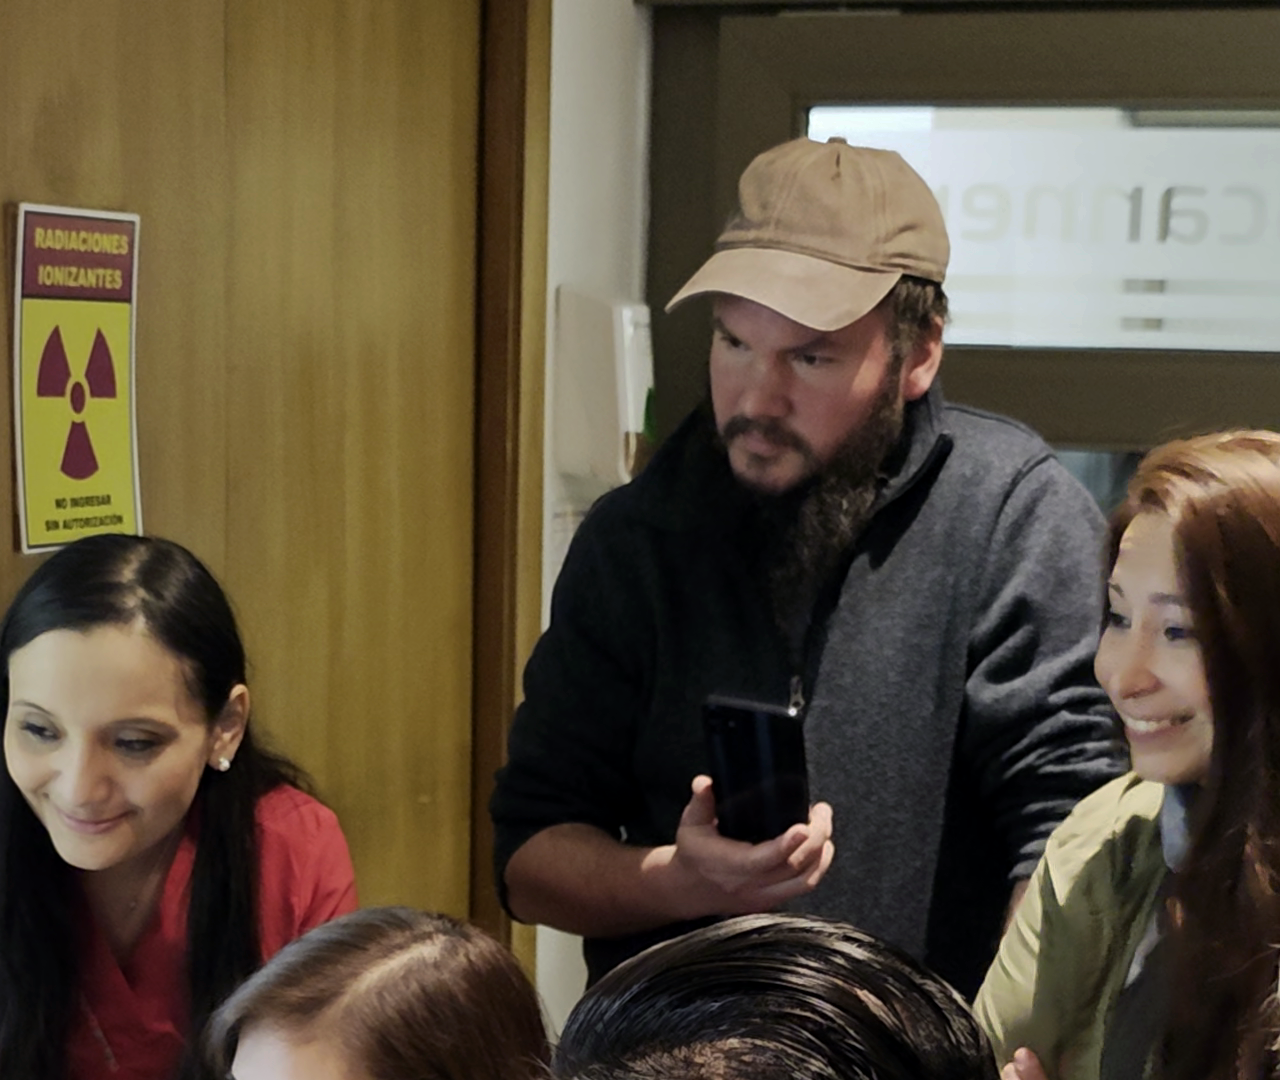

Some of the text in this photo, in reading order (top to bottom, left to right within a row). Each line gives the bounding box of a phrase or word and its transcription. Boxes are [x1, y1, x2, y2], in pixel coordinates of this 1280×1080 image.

[34, 227, 129, 256] RADIACIONES
[37, 265, 124, 290] IONIZANTES
[55, 493, 112, 510] NO INGRESAR
[45, 519, 60, 532] SIN
